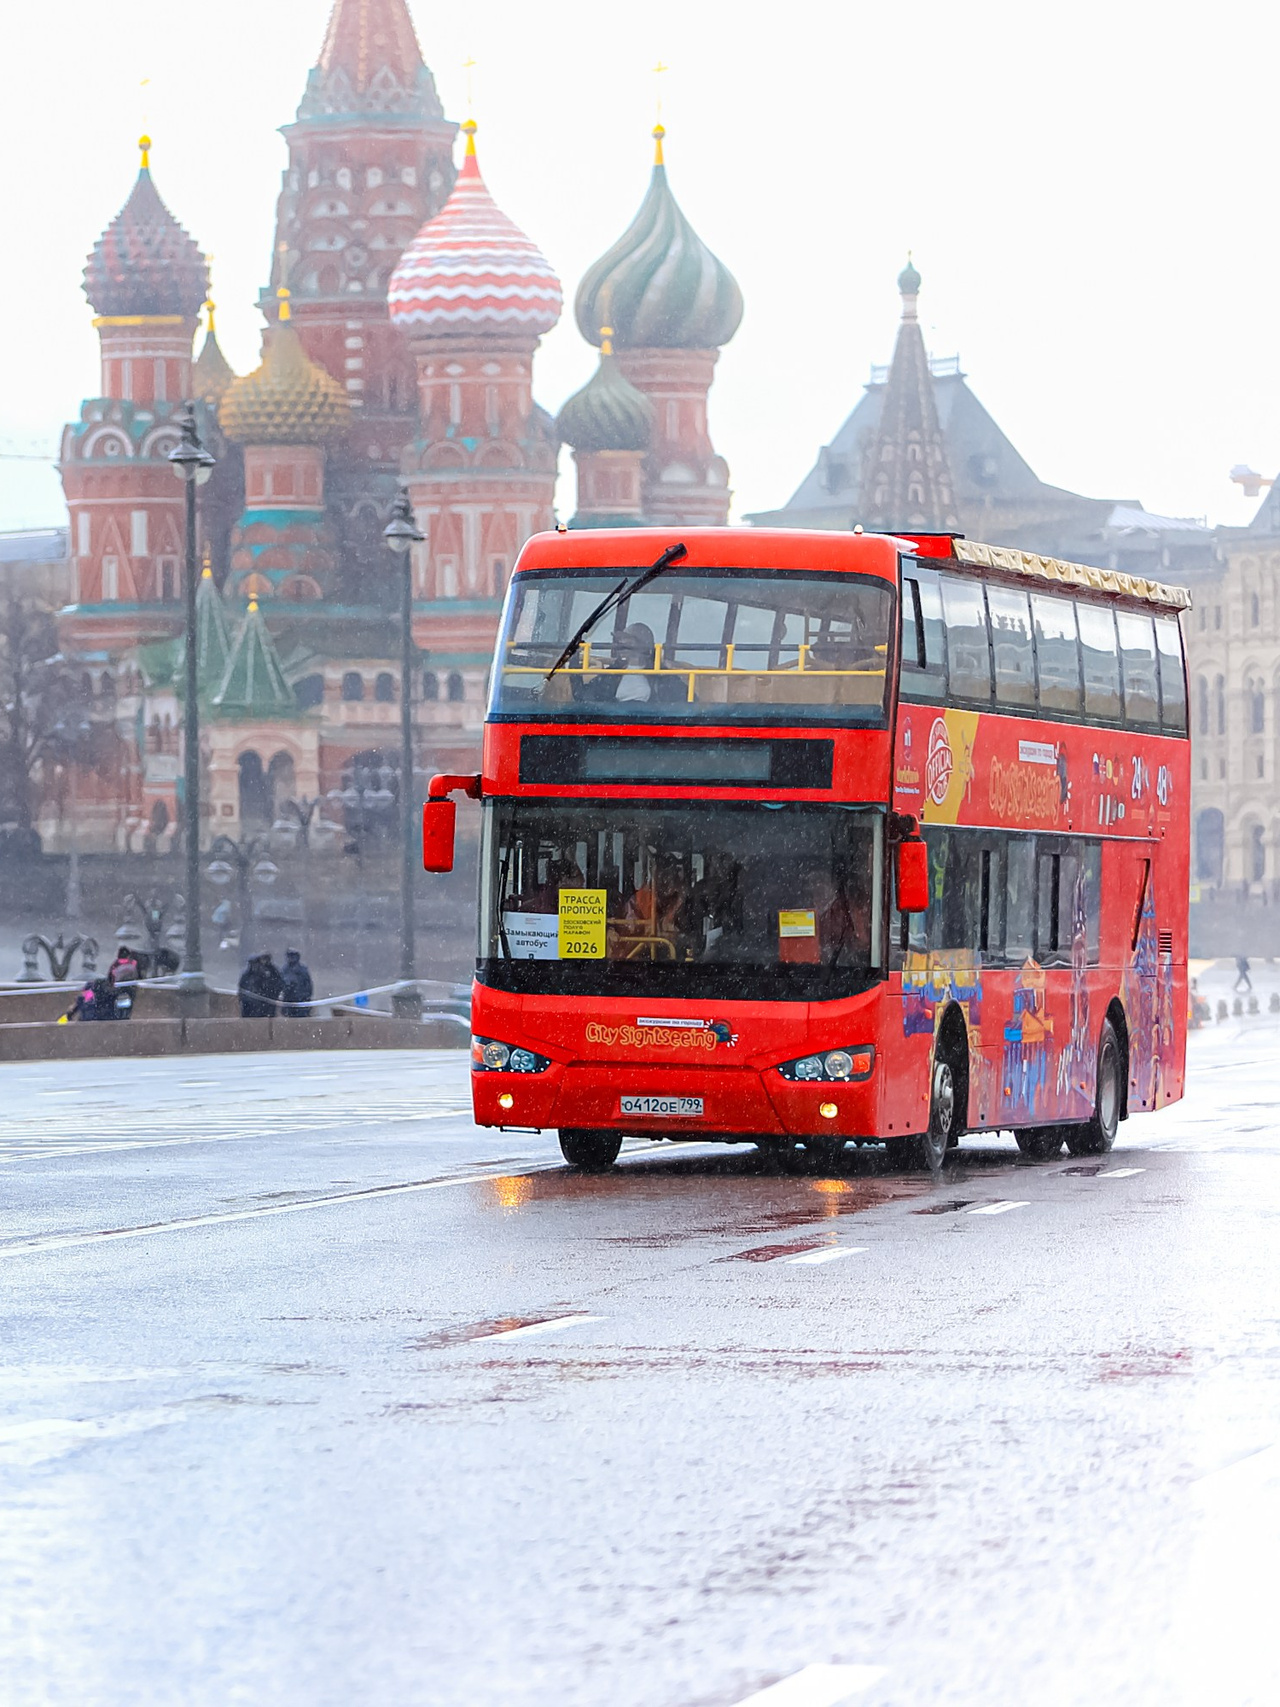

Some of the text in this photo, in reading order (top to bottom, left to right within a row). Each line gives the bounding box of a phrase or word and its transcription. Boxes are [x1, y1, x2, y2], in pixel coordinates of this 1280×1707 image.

[927, 748, 953, 790] OFFICIAL
[564, 896, 601, 905] ТРАССА
[560, 906, 604, 915] ПРОПУСК
[516, 939, 548, 949] автобус
[566, 942, 598, 953] 2026
[586, 1022, 717, 1051] City Sightseeing
[680, 1098, 700, 1109] 799
